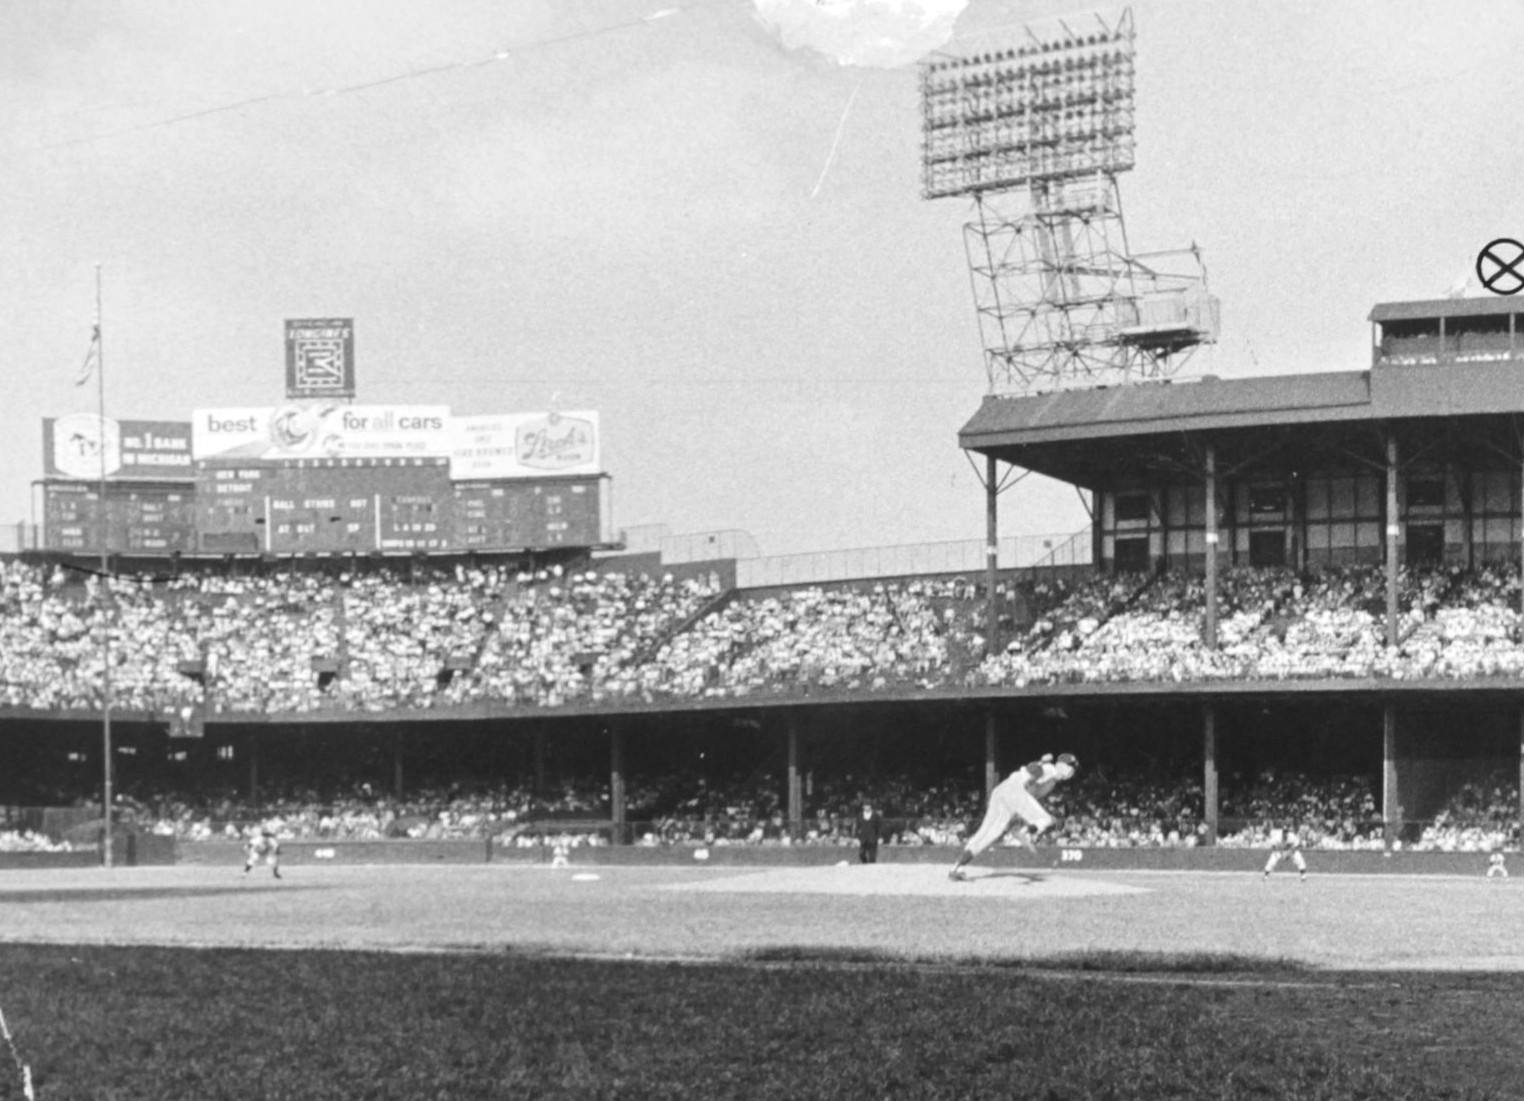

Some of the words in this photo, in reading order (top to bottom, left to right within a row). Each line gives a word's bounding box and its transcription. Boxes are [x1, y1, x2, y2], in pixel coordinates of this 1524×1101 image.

[288, 328, 351, 339] LONGINES
[207, 414, 257, 432] best
[342, 412, 368, 430] for
[372, 411, 394, 430] all
[398, 417, 442, 430] cars
[144, 433, 152, 449] 1
[154, 438, 188, 450] BANK
[122, 453, 135, 464] IN
[137, 453, 191, 466] MICHIGAN
[215, 470, 234, 480] NEW
[238, 469, 260, 479] YORK
[216, 483, 253, 494] DETROIT
[272, 500, 295, 509] BALL
[350, 499, 368, 508] OUT
[278, 524, 290, 534] AT
[297, 523, 315, 533] BAT
[1061, 849, 1084, 861] 370
